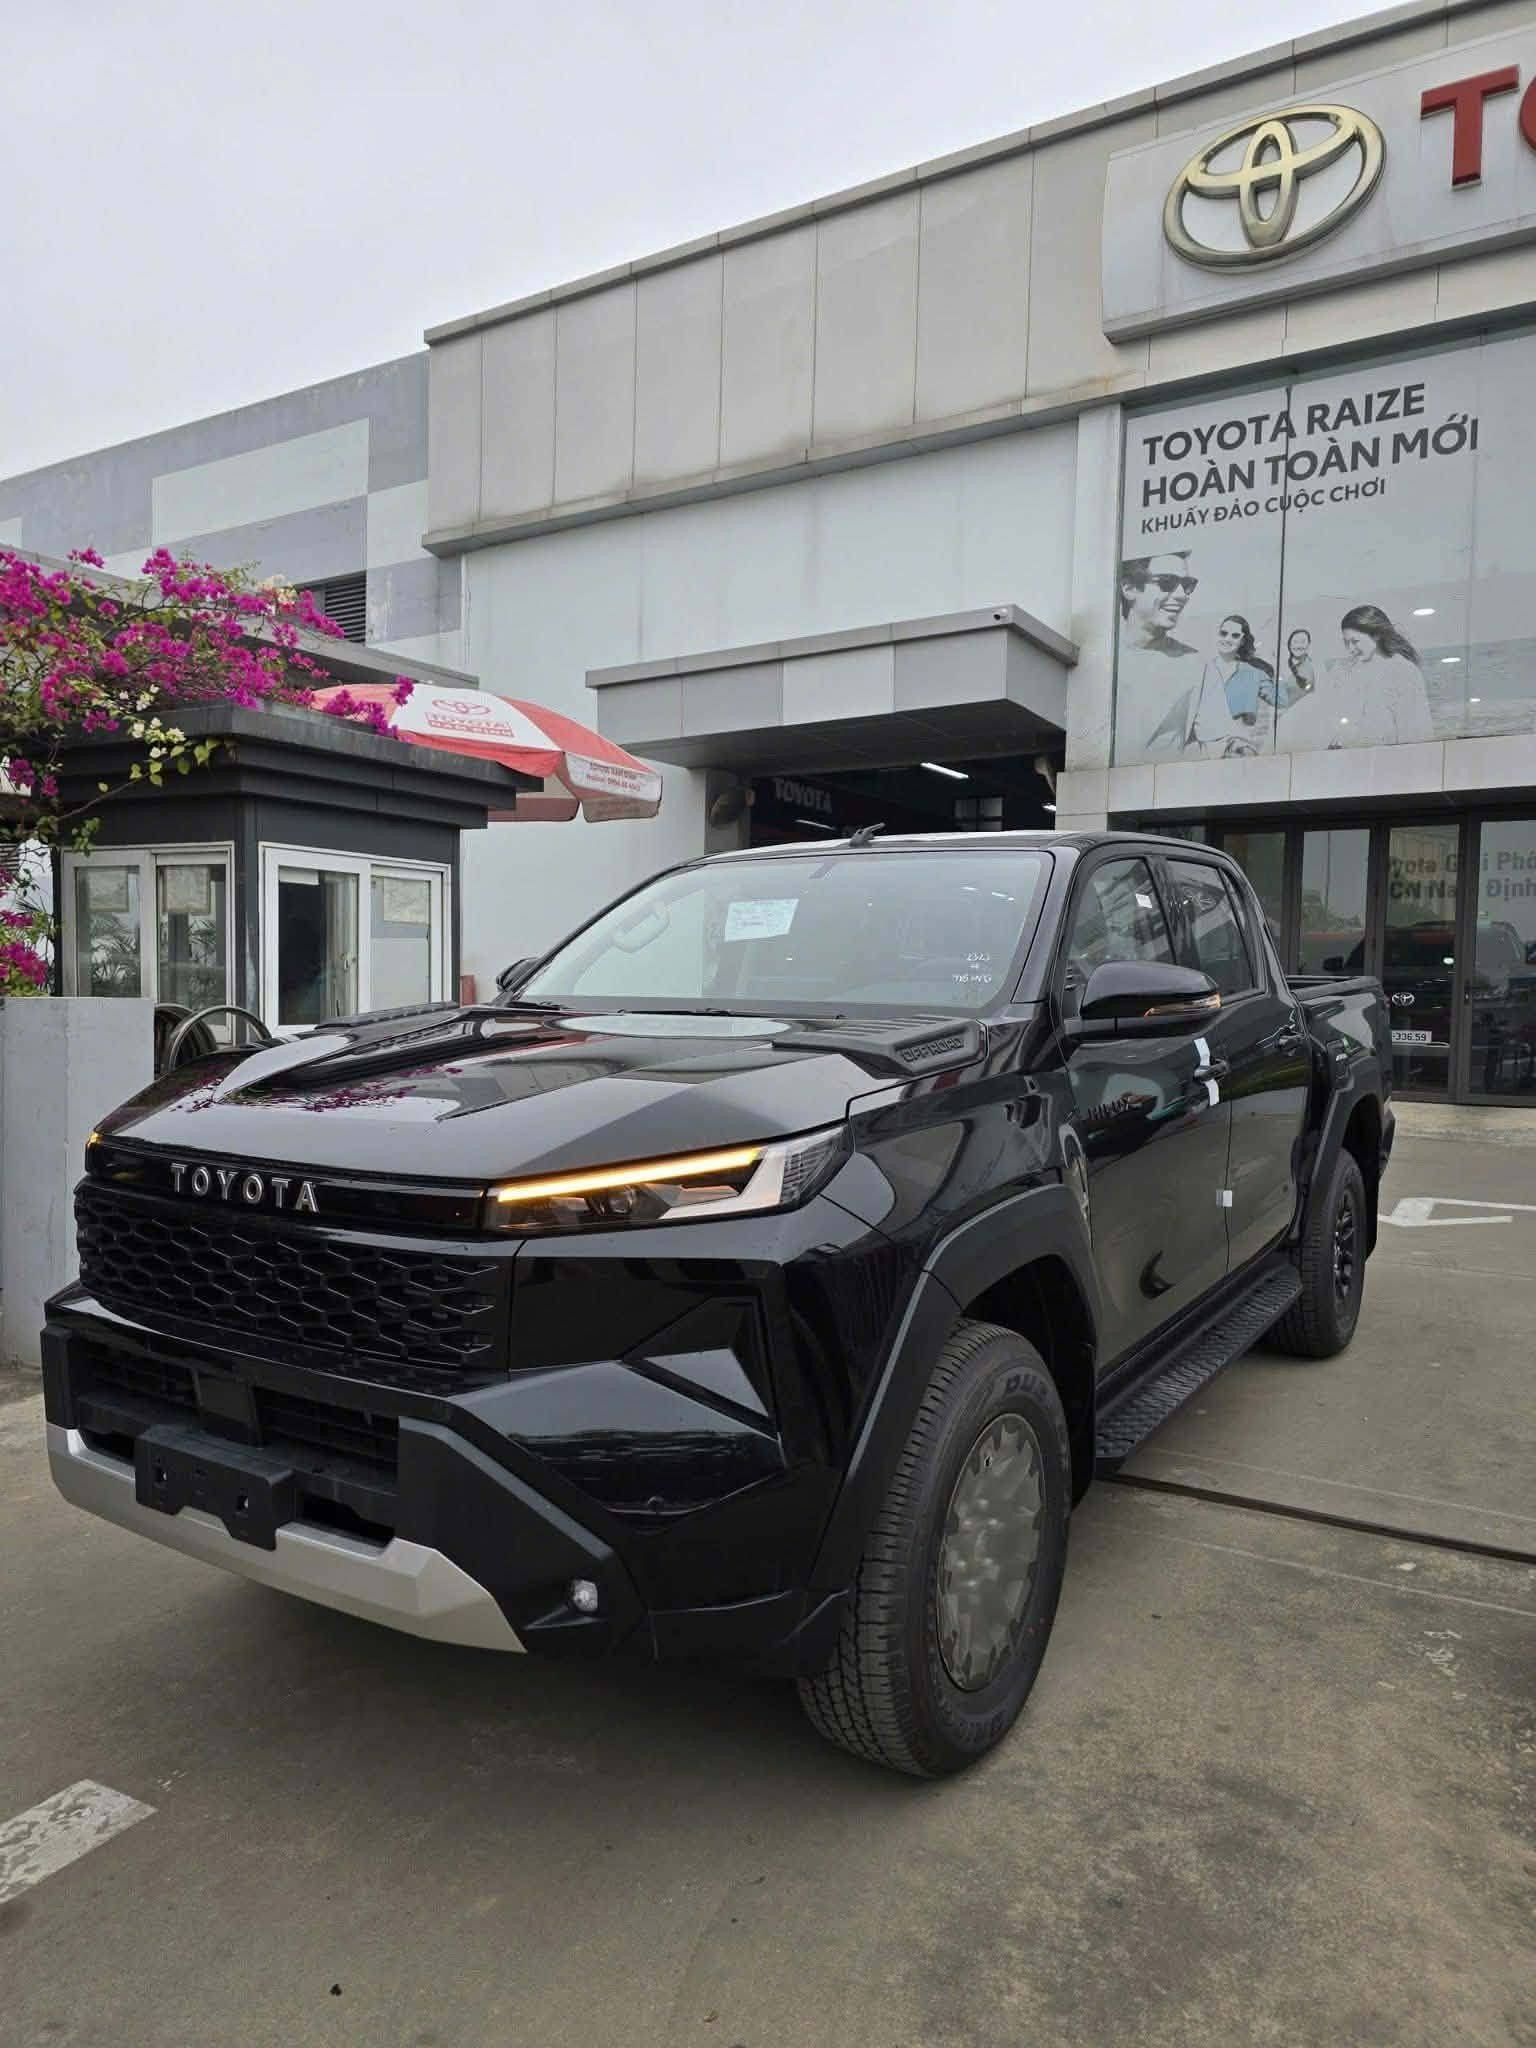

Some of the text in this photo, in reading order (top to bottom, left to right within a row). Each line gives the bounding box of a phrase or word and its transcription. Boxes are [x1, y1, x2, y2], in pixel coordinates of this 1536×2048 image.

[1420, 64, 1536, 192] T
[1142, 383, 1425, 465] TOYOTA RAIZE
[1142, 413, 1479, 507] HOÀN TOÀN MỚI
[1141, 477, 1385, 534] KHUẤY ĐẢO CUỘC CHƠI
[771, 778, 833, 814] TOYOTA
[170, 1162, 320, 1215] TOYOTA
